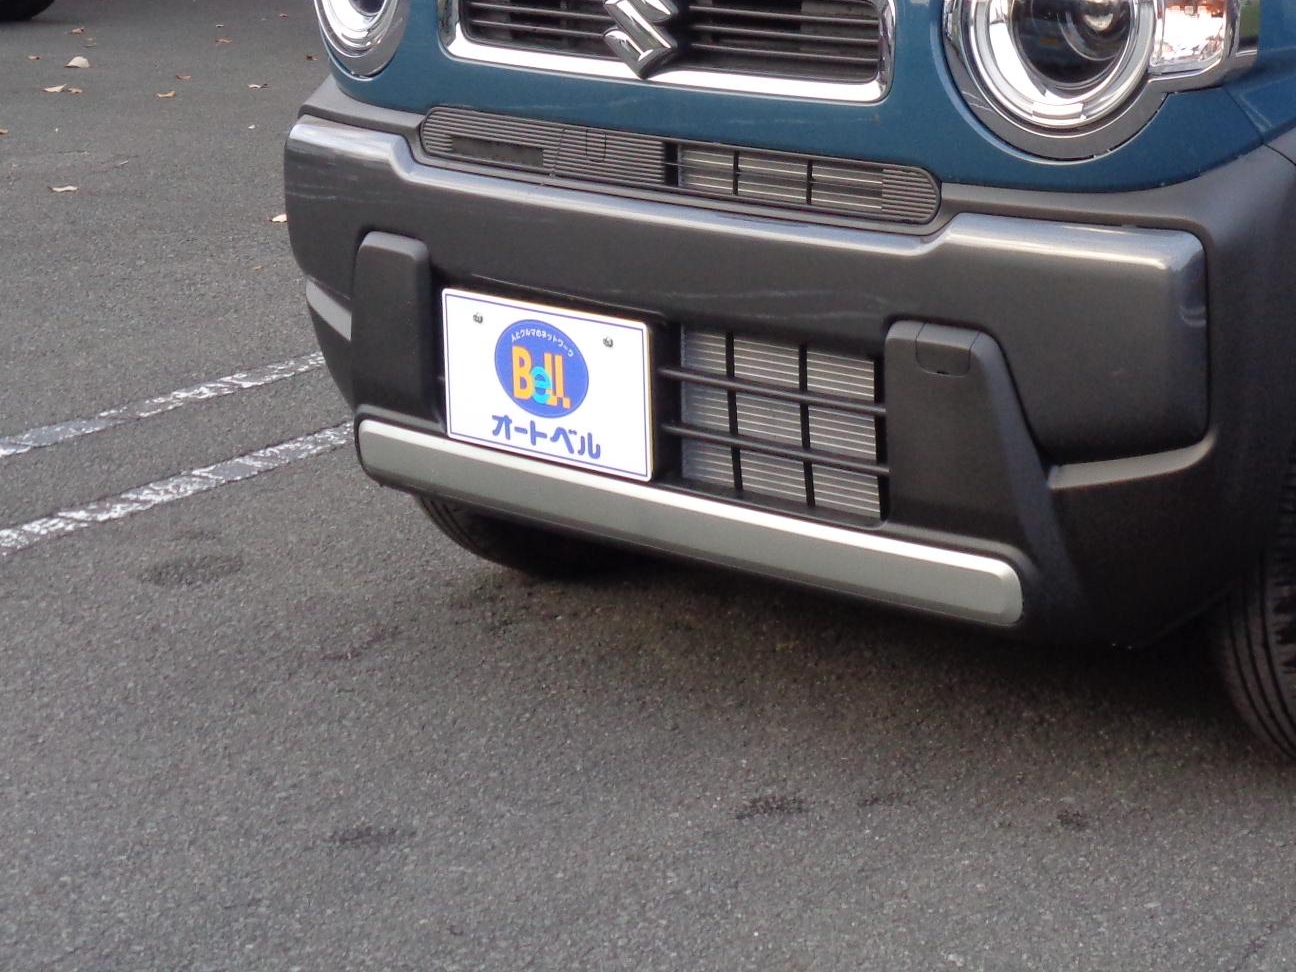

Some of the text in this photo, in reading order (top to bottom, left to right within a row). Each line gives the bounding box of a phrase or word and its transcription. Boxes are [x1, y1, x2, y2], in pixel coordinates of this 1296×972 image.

[492, 415, 601, 459] オートベル
